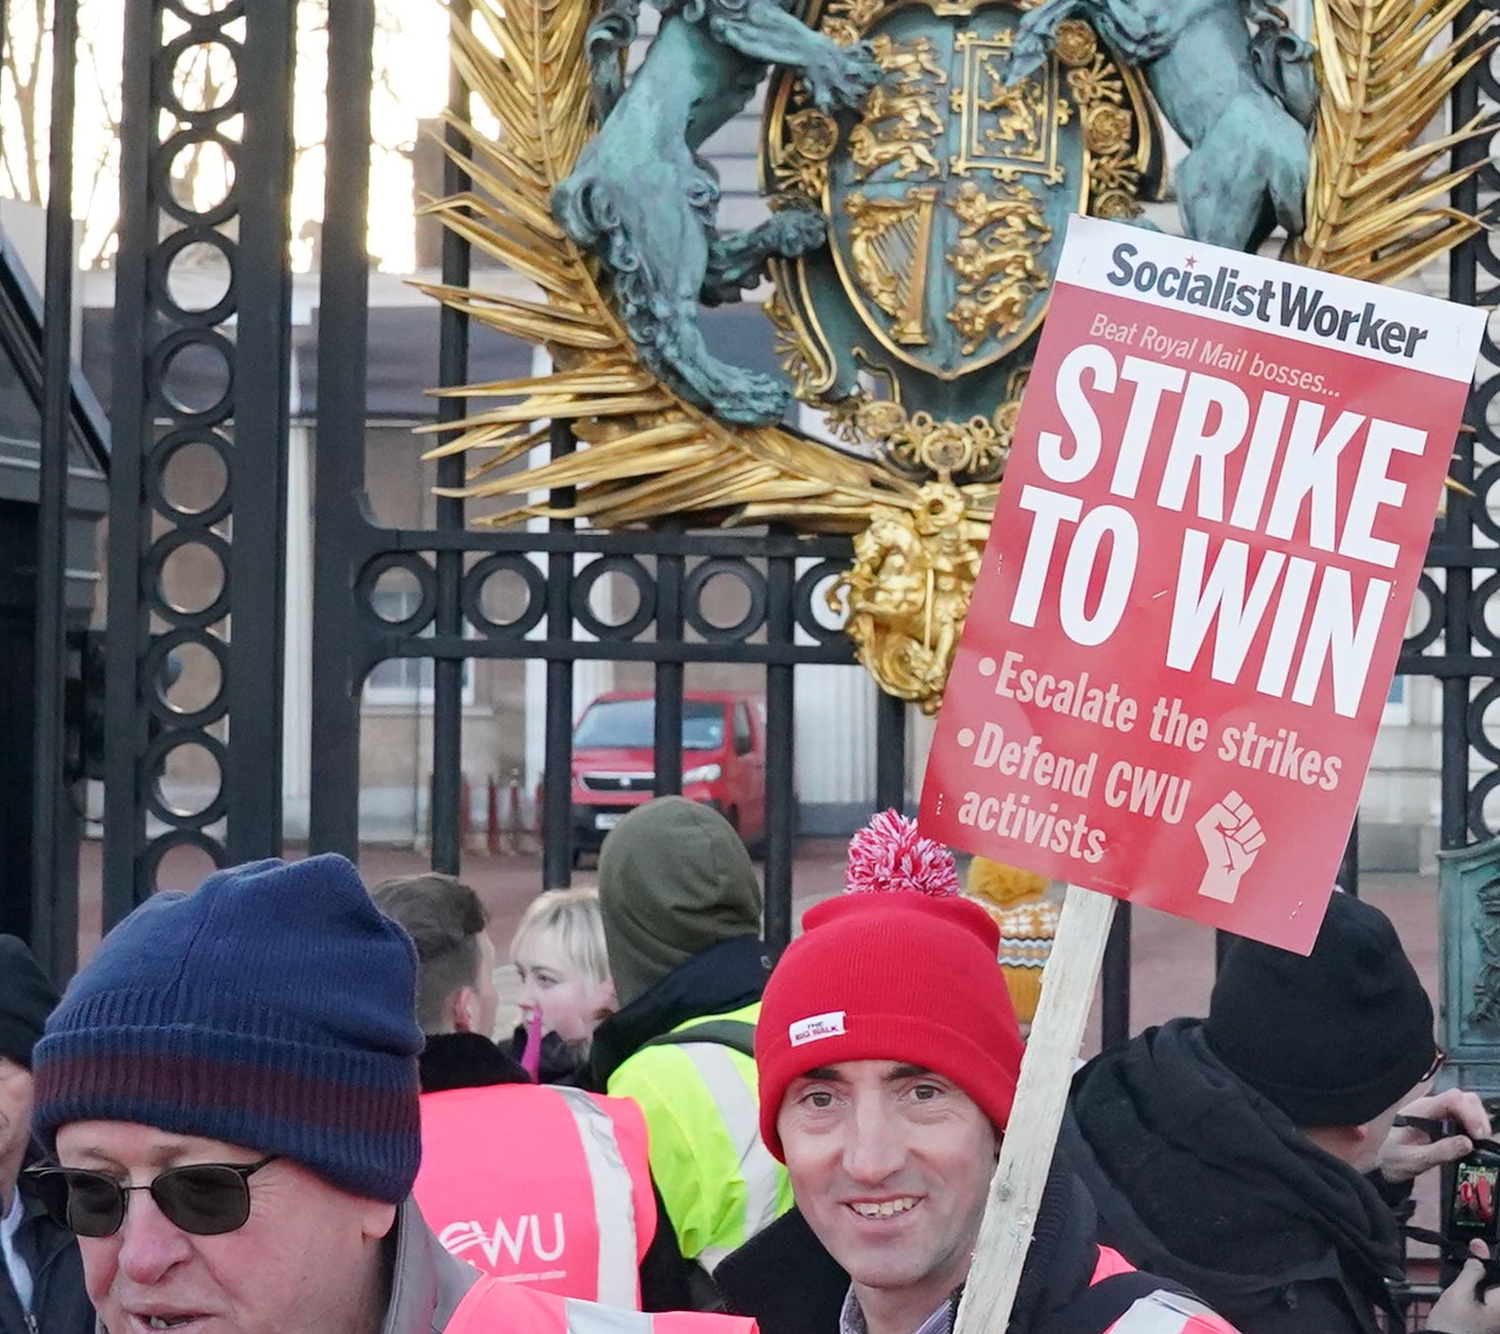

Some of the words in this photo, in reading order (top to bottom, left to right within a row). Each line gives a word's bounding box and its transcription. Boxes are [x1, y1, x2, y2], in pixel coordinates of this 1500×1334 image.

[1089, 313, 1138, 345] Beat
[1139, 325, 1198, 360] Royal
[1198, 340, 1248, 372] Mail
[1249, 353, 1340, 397] bosses...
[1037, 344, 1428, 568] STRIKE
[1009, 484, 1139, 646] TO
[1166, 528, 1392, 718] WIN
[973, 721, 1098, 798] Defend
[1104, 760, 1192, 824] CWU
[994, 650, 1138, 732] Escalate
[1149, 696, 1209, 752] the
[1217, 721, 1342, 791] strikes
[958, 791, 1106, 863] activists
